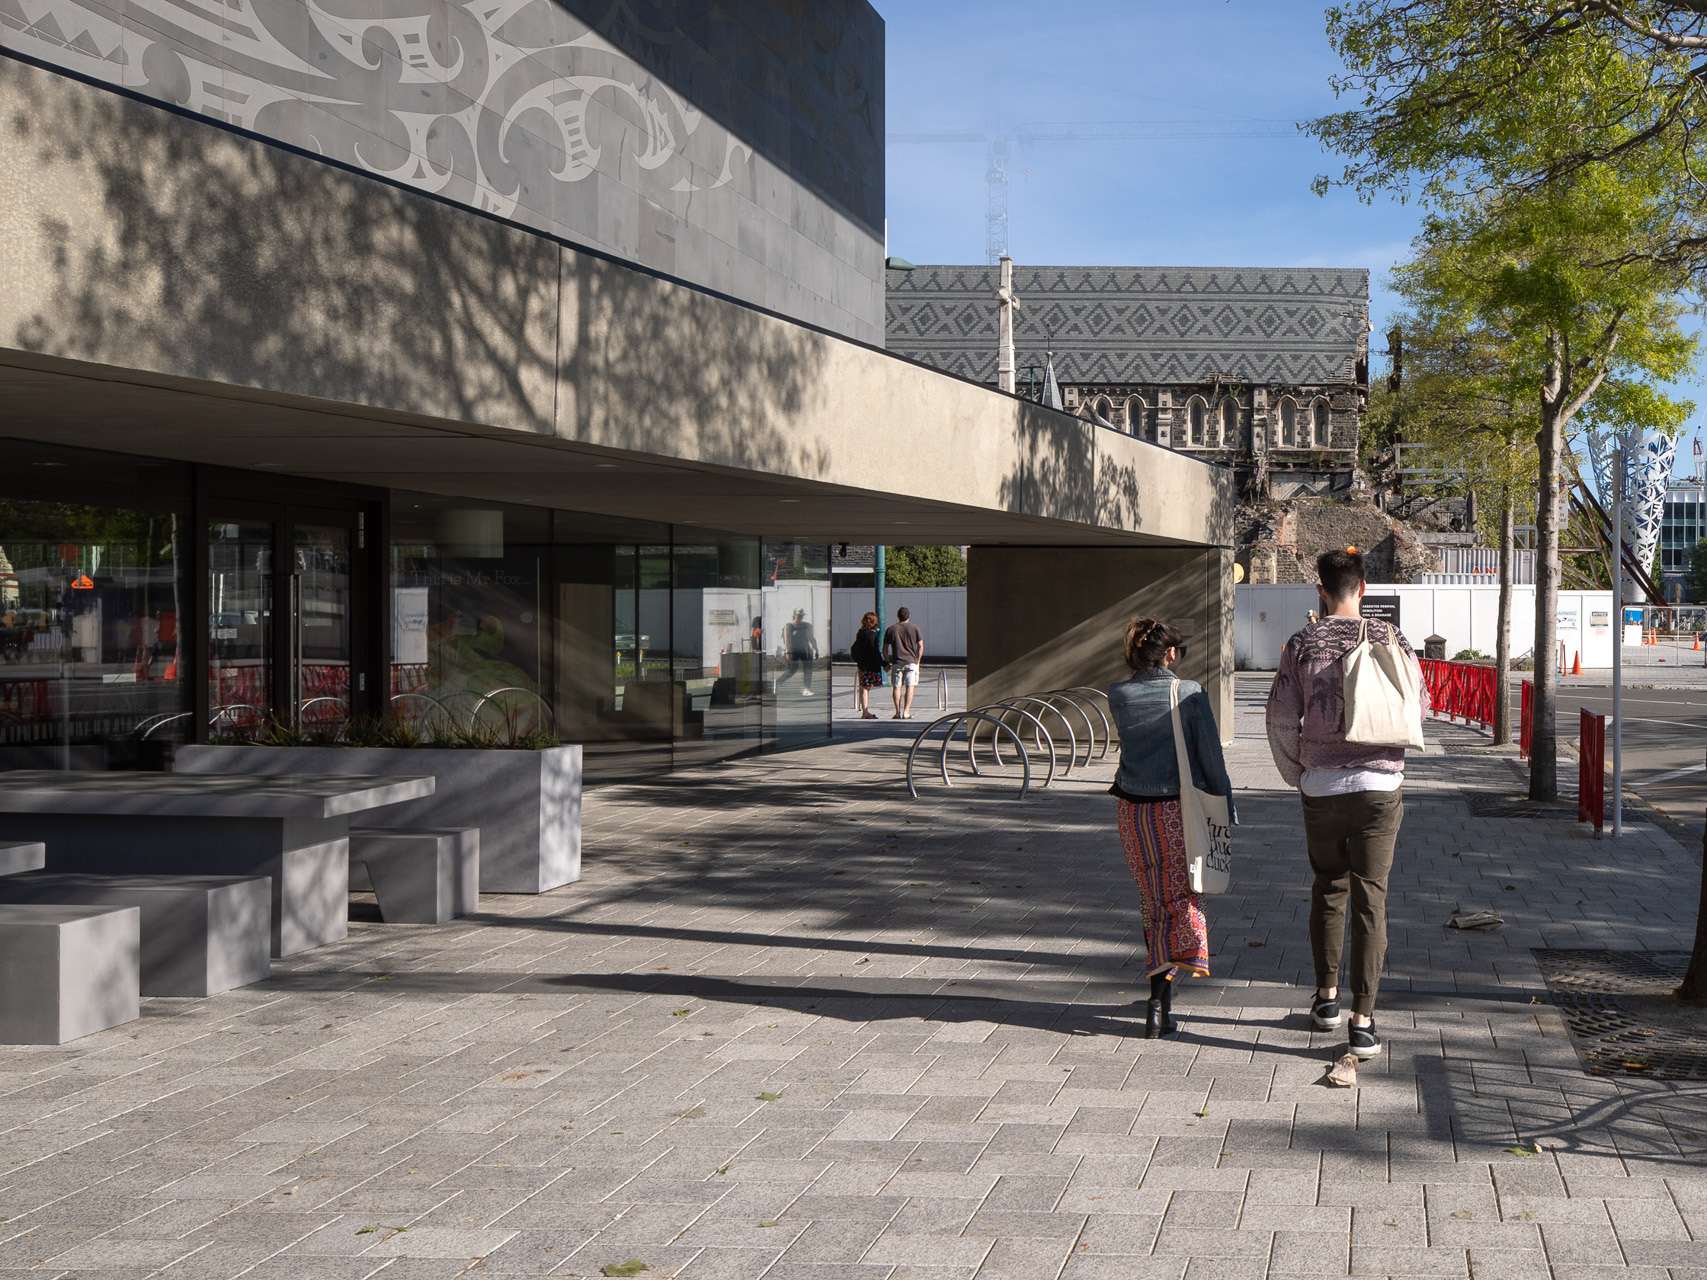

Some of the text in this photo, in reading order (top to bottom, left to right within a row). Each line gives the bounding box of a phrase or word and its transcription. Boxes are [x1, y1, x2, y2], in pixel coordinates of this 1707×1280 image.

[411, 570, 445, 586] This
[450, 572, 461, 586] is
[464, 570, 491, 586] Mr
